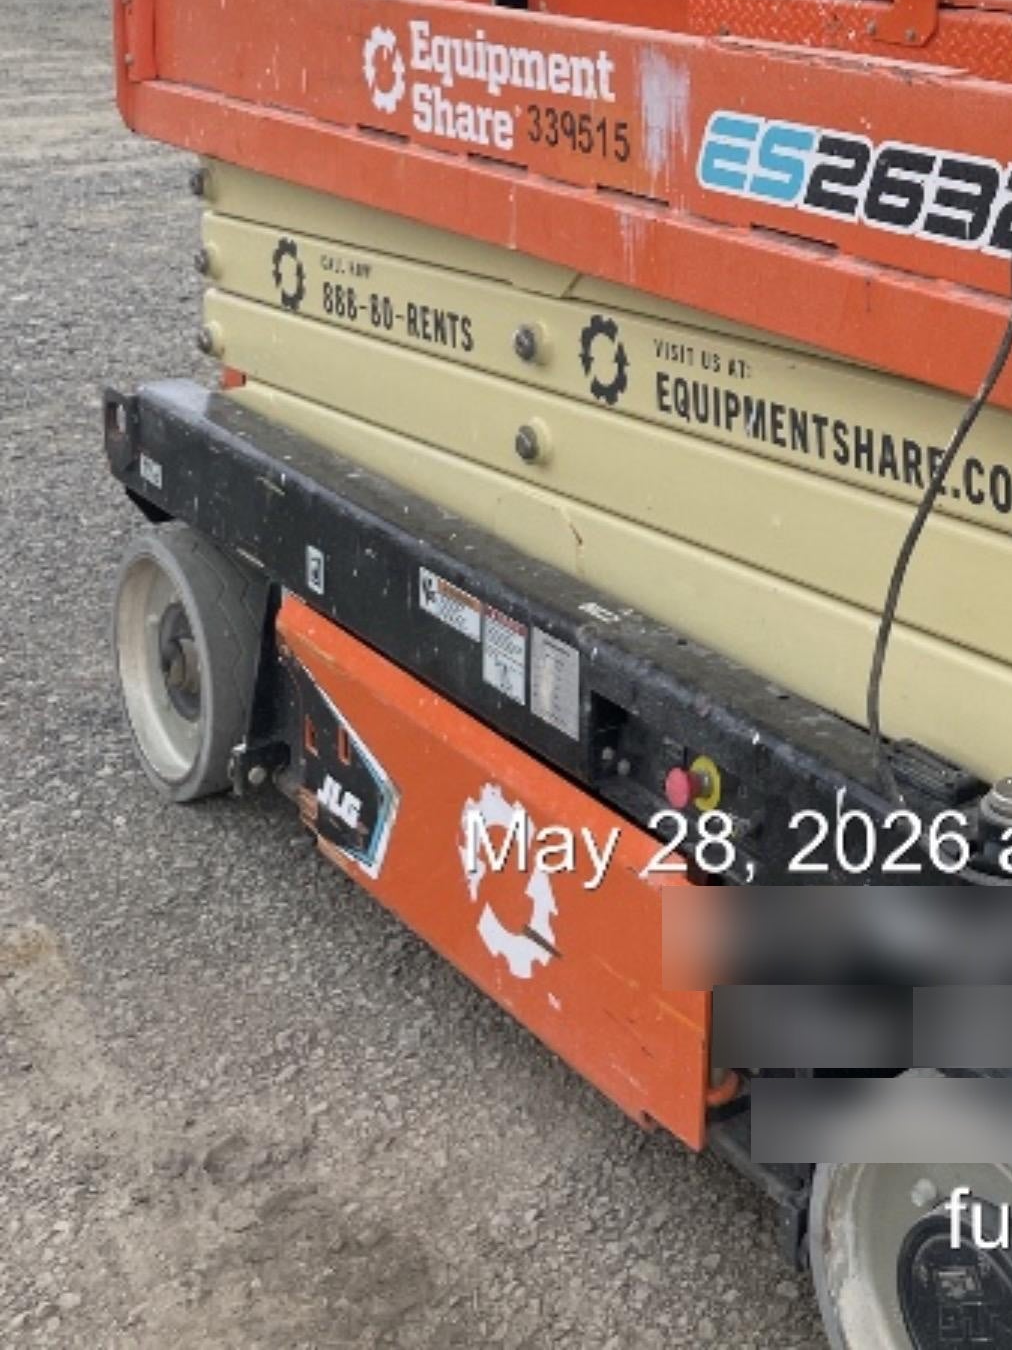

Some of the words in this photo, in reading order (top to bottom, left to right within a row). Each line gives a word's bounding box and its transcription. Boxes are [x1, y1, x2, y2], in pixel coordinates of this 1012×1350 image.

[408, 20, 616, 102] Equipment
[411, 83, 514, 151] Share
[526, 104, 631, 163] 339515
[323, 282, 475, 352] 888-80-RENTS
[653, 339, 694, 366] VISIT
[701, 350, 721, 373] US
[728, 359, 752, 379] AT:
[317, 774, 362, 829] JLG
